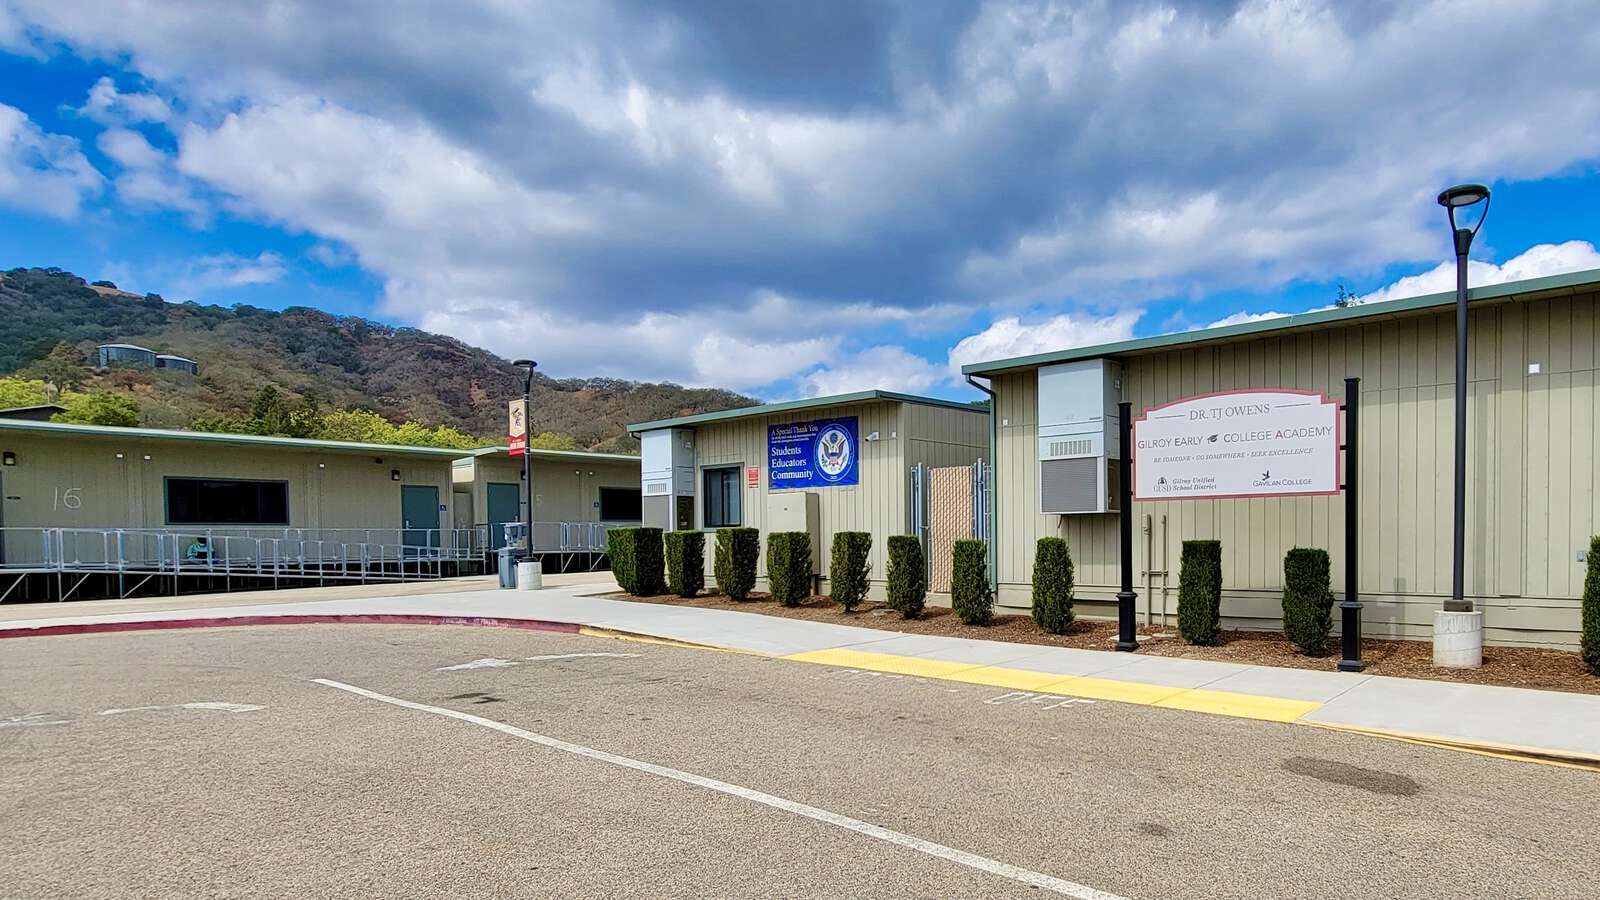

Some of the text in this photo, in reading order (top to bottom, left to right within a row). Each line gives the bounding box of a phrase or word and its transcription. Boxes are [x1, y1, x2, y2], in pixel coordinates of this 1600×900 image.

[1190, 403, 1270, 421] DR. TJ OWENS
[771, 424, 819, 436] A Special Thank You
[1137, 426, 1332, 449] GILROY EARLY COLLEGE ACADEMY
[771, 446, 802, 457] Students
[1162, 455, 1192, 463] SOMEONE
[1206, 451, 1246, 460] SOMEWHERE
[1268, 447, 1314, 457] EXCELLENCE
[771, 459, 807, 468] Educators
[771, 470, 814, 480] Community
[1192, 476, 1215, 484] Unified
[1172, 483, 1217, 492] School District
[1252, 478, 1313, 488] GAVILAN COLLEGE
[54, 487, 82, 511] 16
